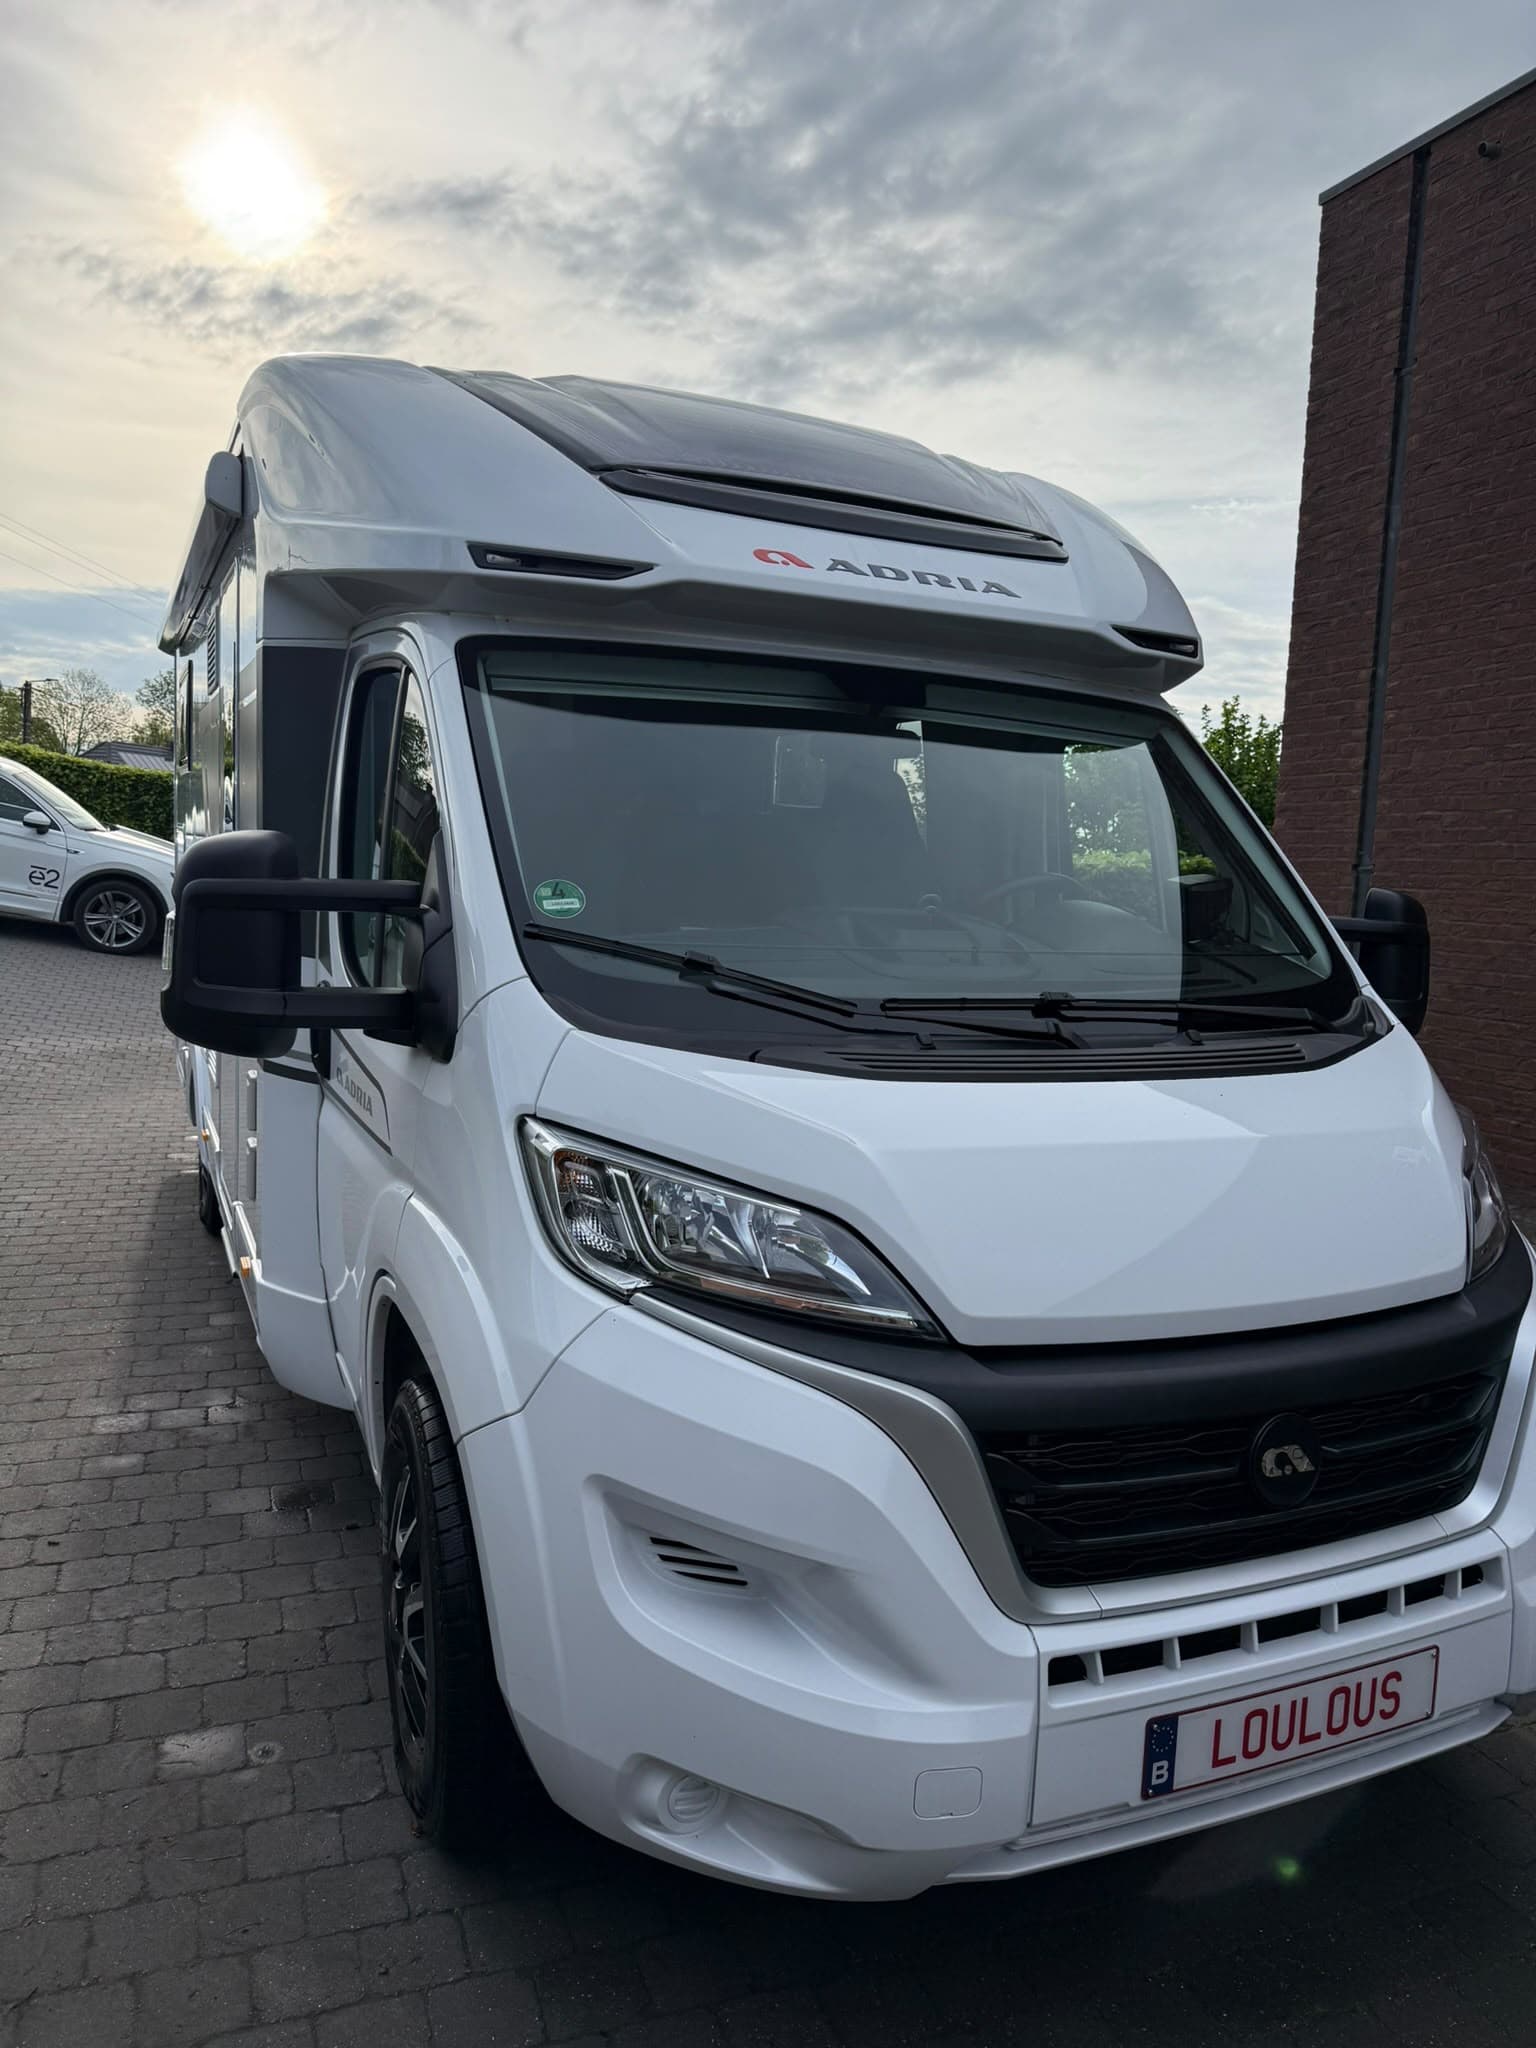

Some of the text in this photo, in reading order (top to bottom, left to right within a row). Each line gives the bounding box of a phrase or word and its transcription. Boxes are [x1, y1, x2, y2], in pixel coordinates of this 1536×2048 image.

[826, 558, 1022, 598] ADRIA
[344, 1075, 373, 1116] ADRIA
[1151, 1671, 1402, 1785] B LOULOUS
